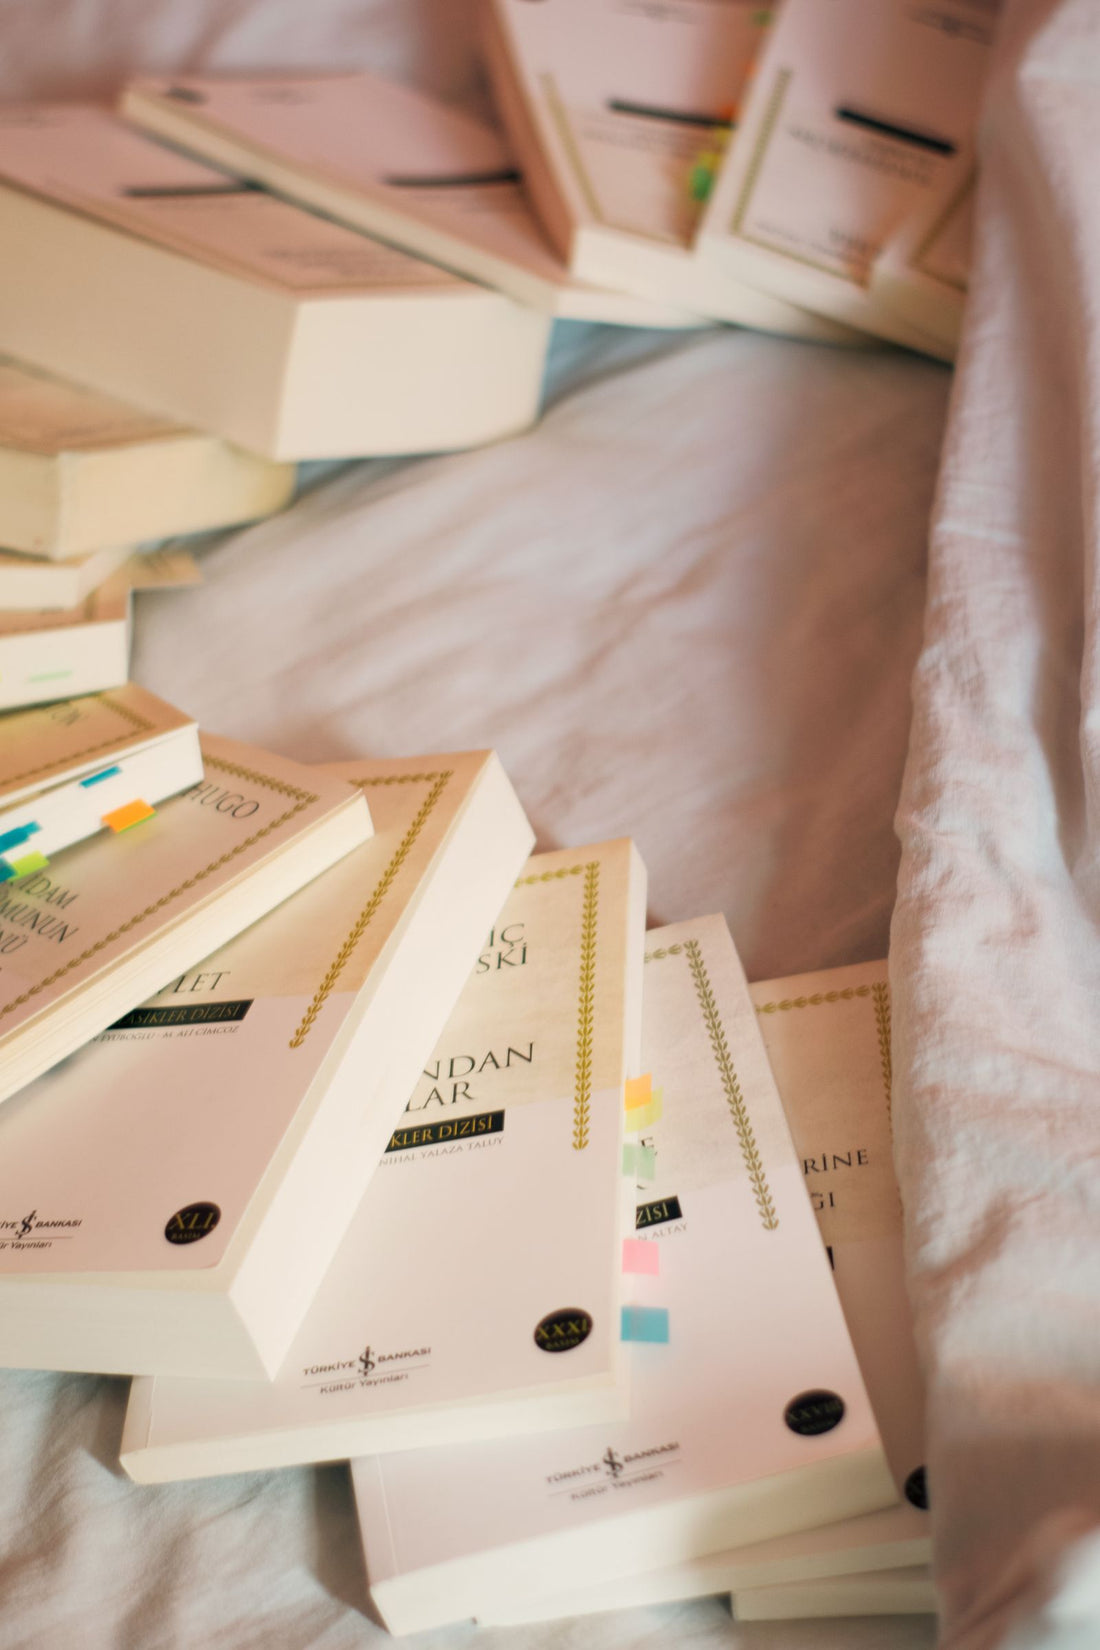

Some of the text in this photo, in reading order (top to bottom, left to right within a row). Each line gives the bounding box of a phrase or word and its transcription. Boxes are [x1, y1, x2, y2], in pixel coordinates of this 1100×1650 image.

[303, 1346, 432, 1376] TÜRKİYE BANKASI
[319, 1373, 409, 1395] Kültür Yayınları
